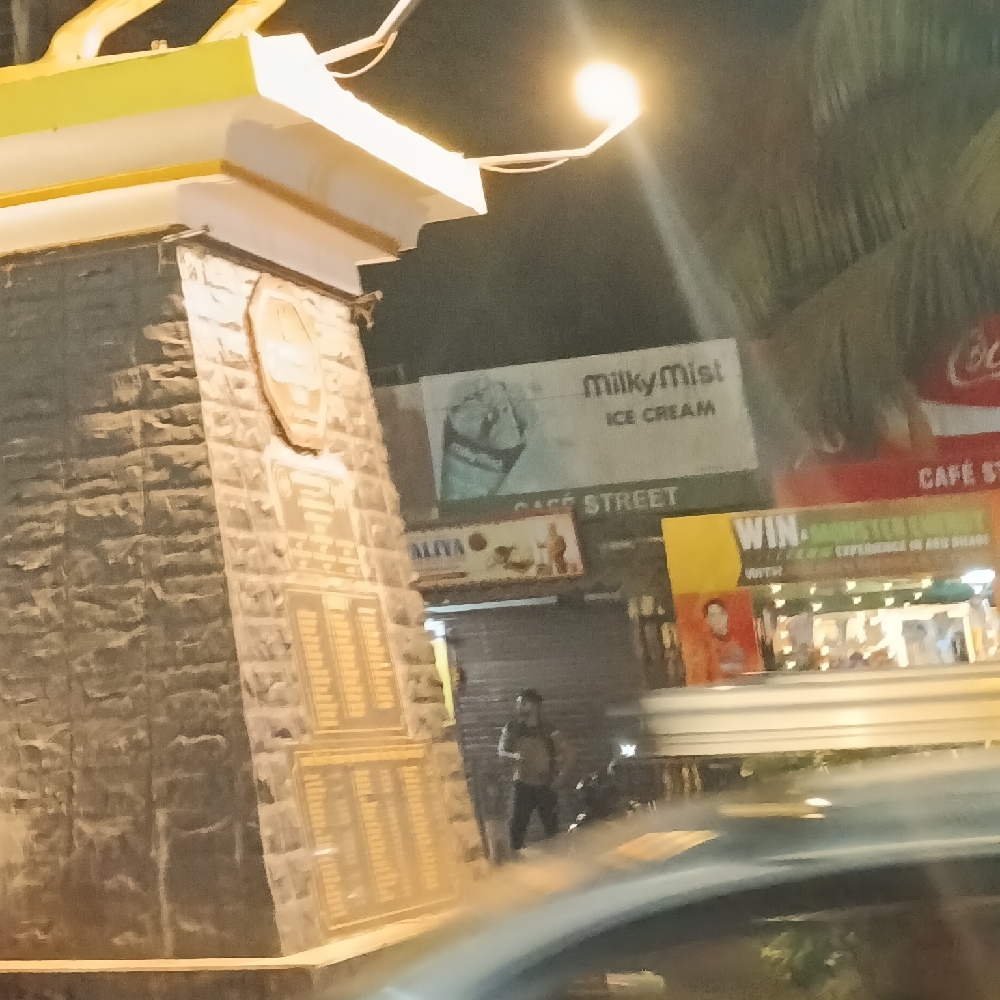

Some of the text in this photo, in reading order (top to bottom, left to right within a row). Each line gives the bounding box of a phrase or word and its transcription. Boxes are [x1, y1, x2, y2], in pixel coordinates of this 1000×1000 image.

[606, 400, 717, 426] ICE CREAM
[584, 486, 679, 516] STREET
[734, 514, 800, 550] WIN
